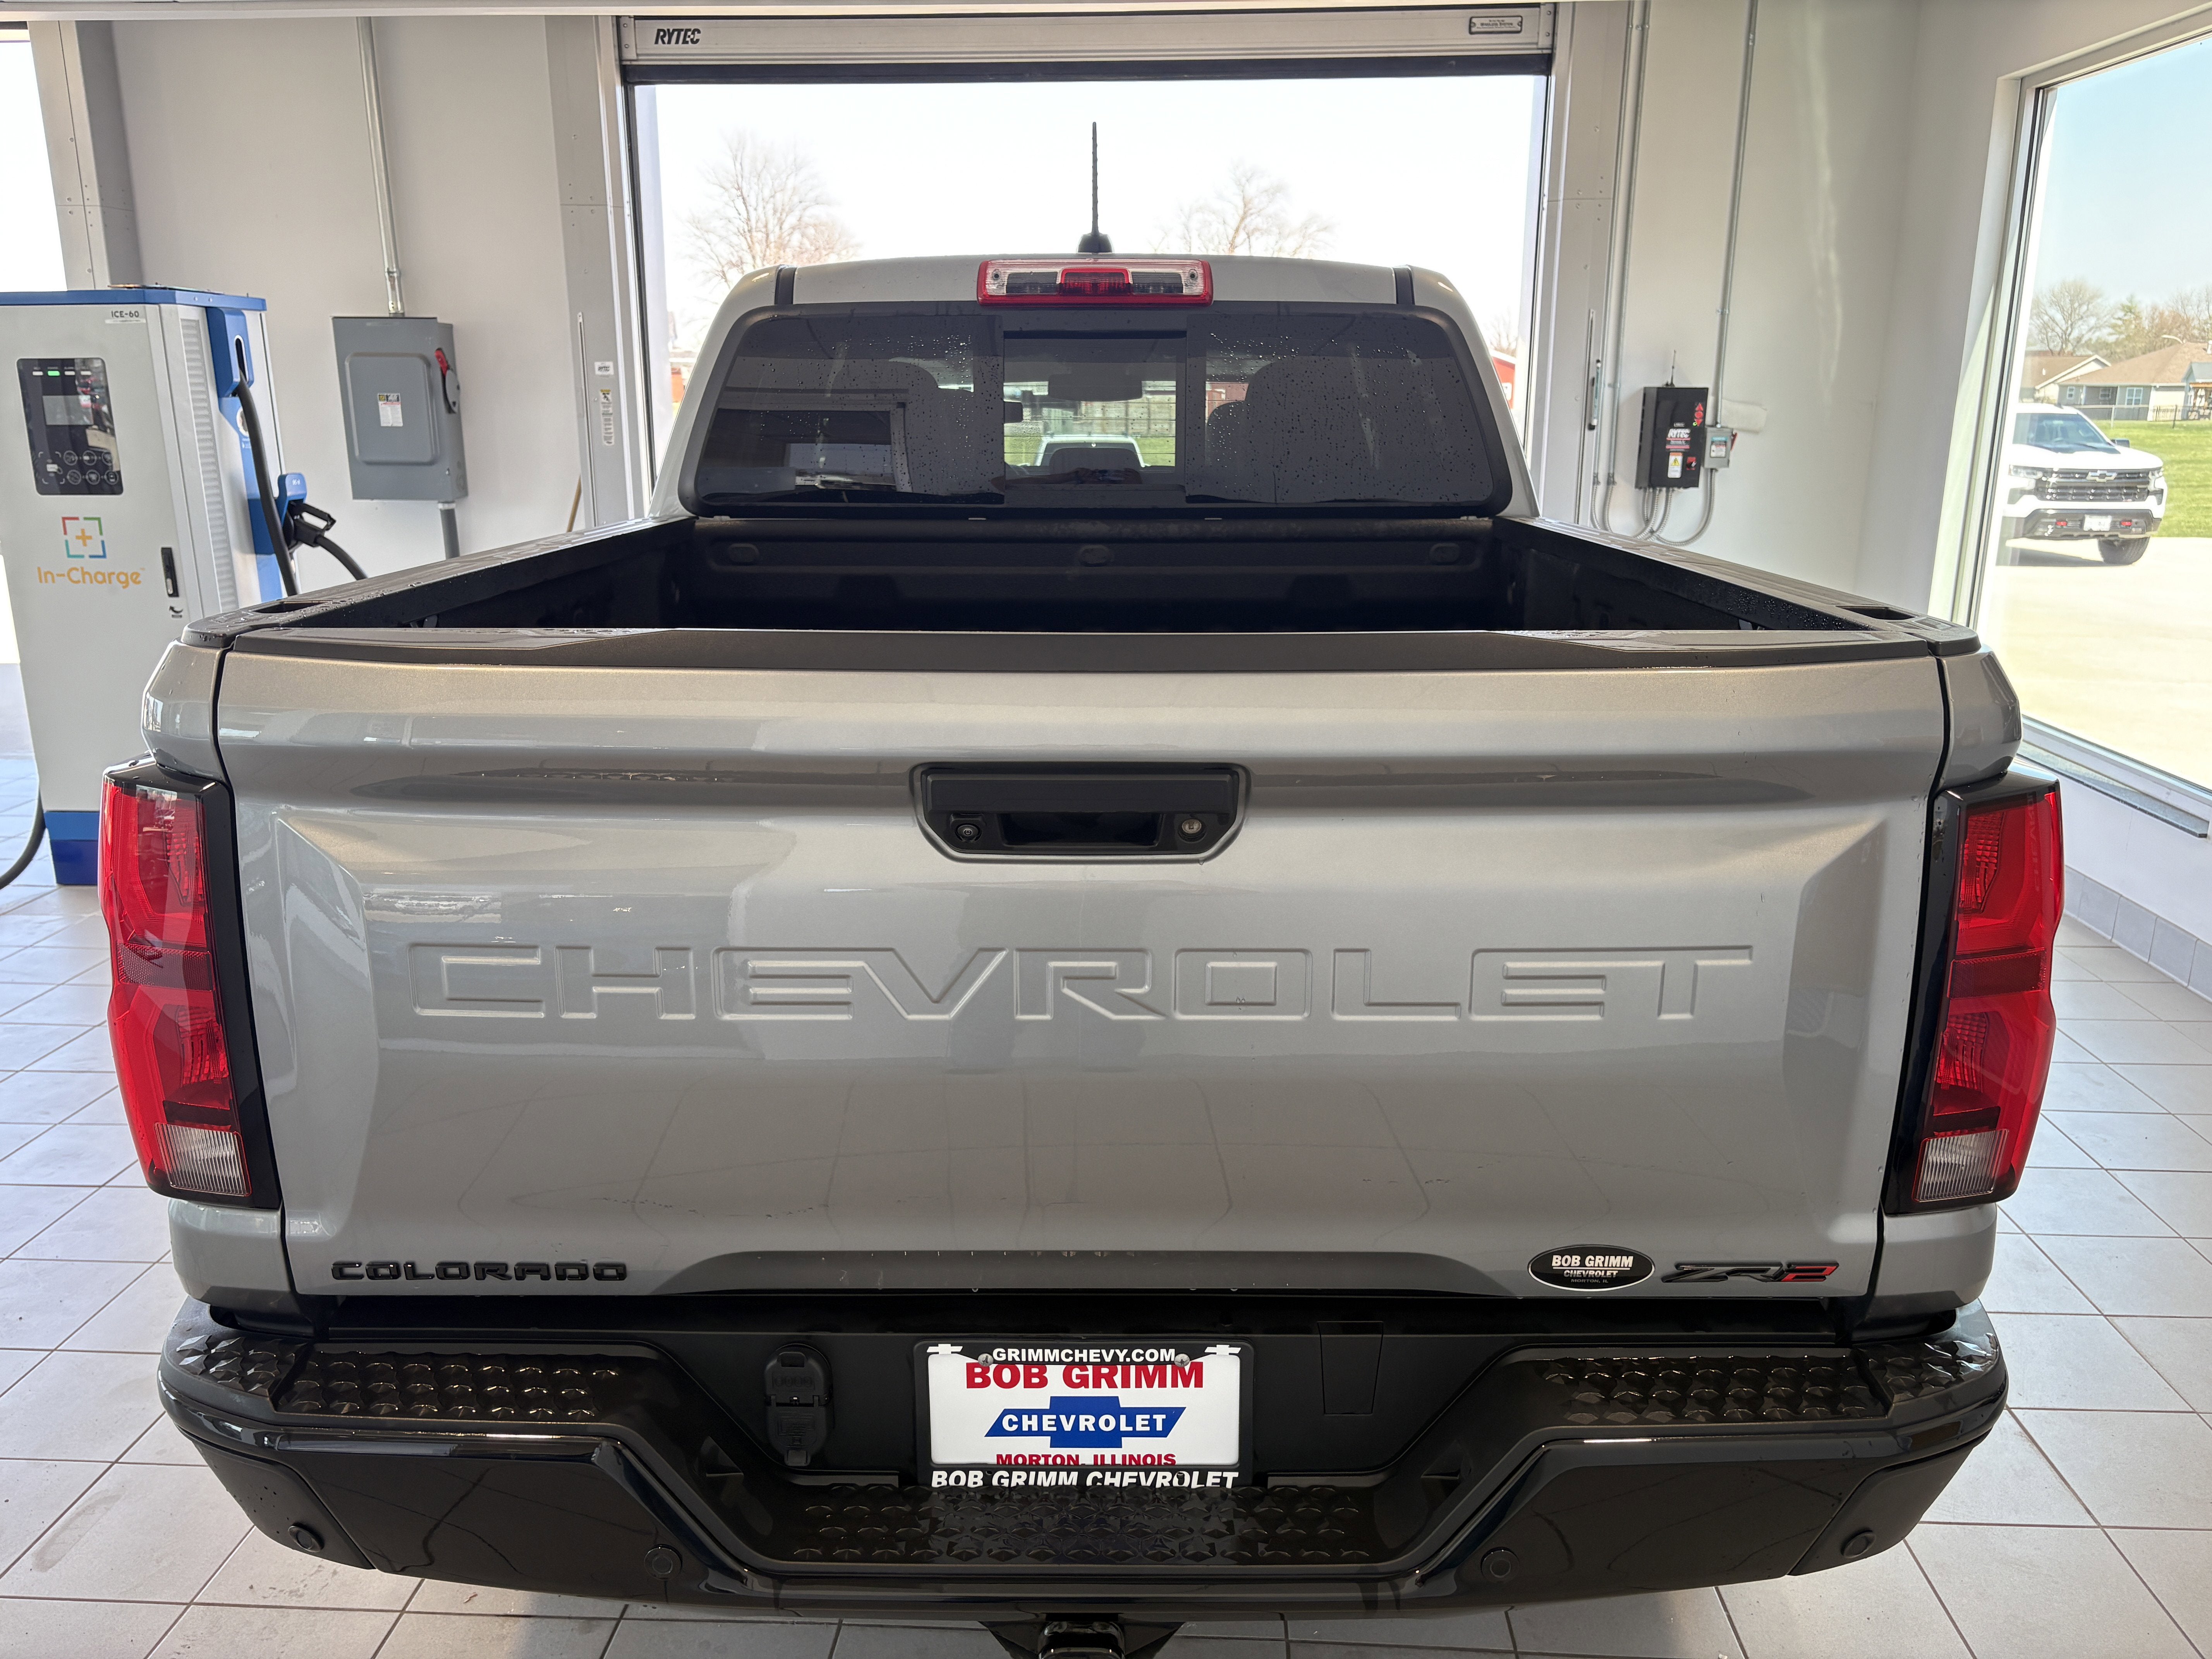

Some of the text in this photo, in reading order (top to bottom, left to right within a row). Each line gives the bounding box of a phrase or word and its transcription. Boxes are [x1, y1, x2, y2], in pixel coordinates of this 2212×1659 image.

[654, 28, 701, 45] RYTEC
[37, 566, 141, 589] In-Charge
[408, 943, 1753, 1021] CHEVROLET
[1552, 1255, 1633, 1267] BOB GRIMM
[331, 1261, 627, 1281] COLORADO
[1661, 1261, 1839, 1283] ZR2
[992, 1348, 1175, 1363] GRIMMCHEVY.COM
[966, 1362, 1203, 1389] BOB GRIMM
[1001, 1414, 1166, 1432] CHEVROLET
[1093, 1453, 1176, 1465] ILLINOIS
[931, 1470, 1239, 1489] BOB GRIMM CHEVROLET
